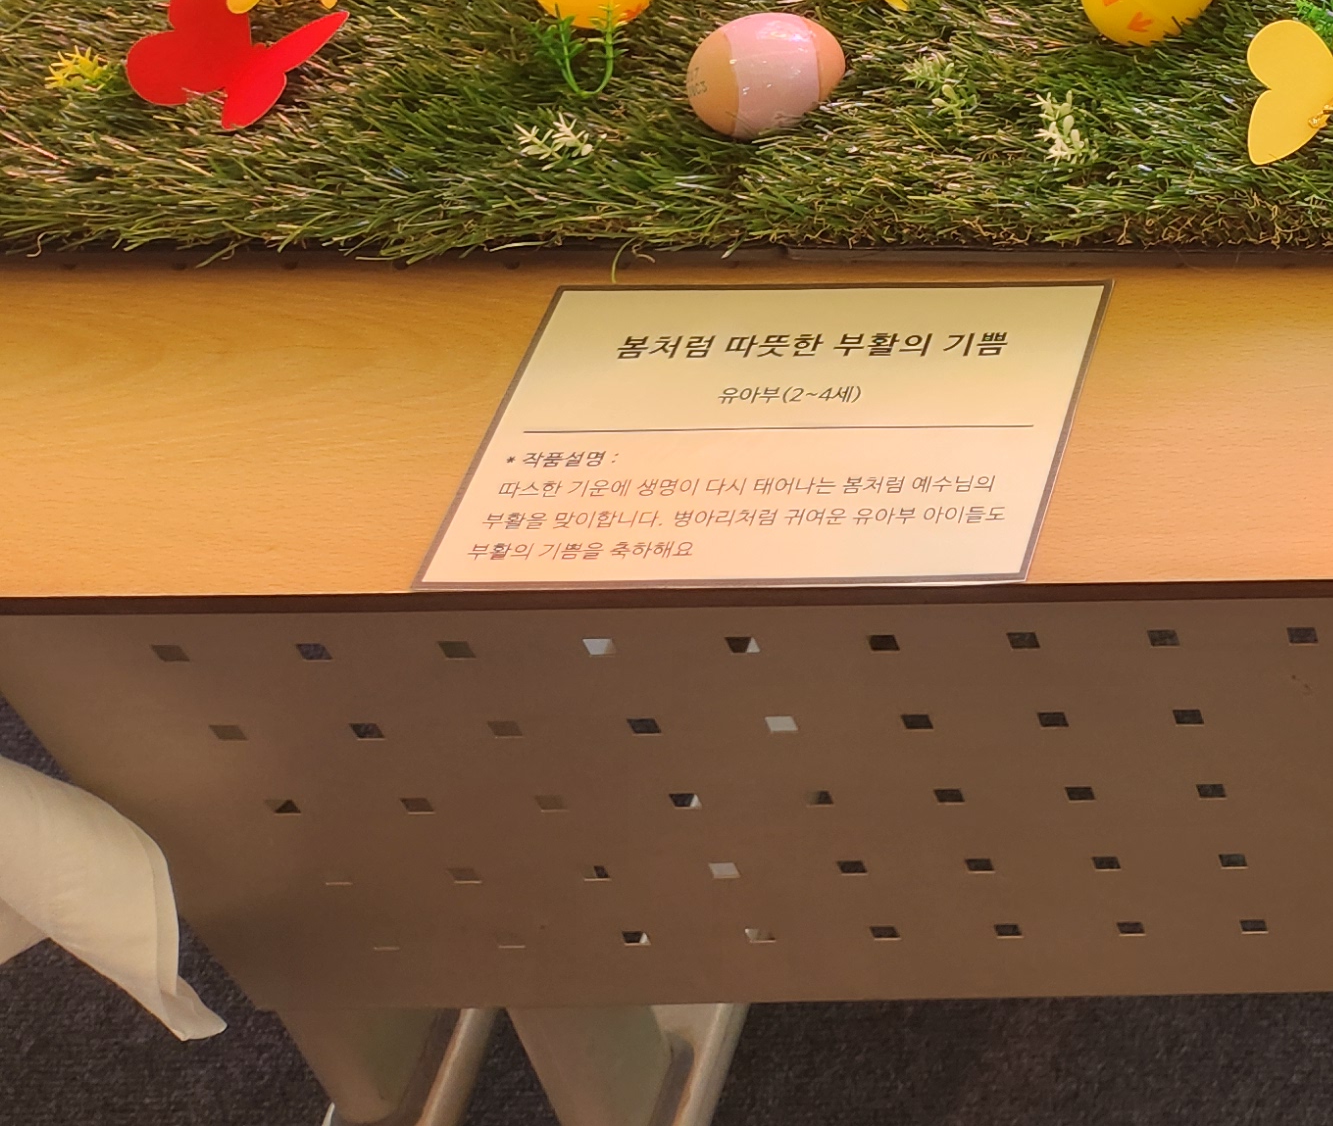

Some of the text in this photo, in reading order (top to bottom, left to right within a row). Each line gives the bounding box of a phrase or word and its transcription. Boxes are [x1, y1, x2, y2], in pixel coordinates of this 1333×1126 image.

[616, 331, 1009, 360] 봄처럼 따뜻한 부활의 기쁨
[717, 385, 862, 405] 유아부(2~4세)
[522, 450, 607, 469] 작품설명
[497, 474, 996, 499] 따스한 기운에 생명이 다시 태어나는 봄처럼 예수님의
[481, 505, 1006, 530] 부활을 맞이합니다. 병아리처럼 귀여운 유아부 아이들도
[466, 540, 694, 561] 부활의 기쁨을 축하해요
